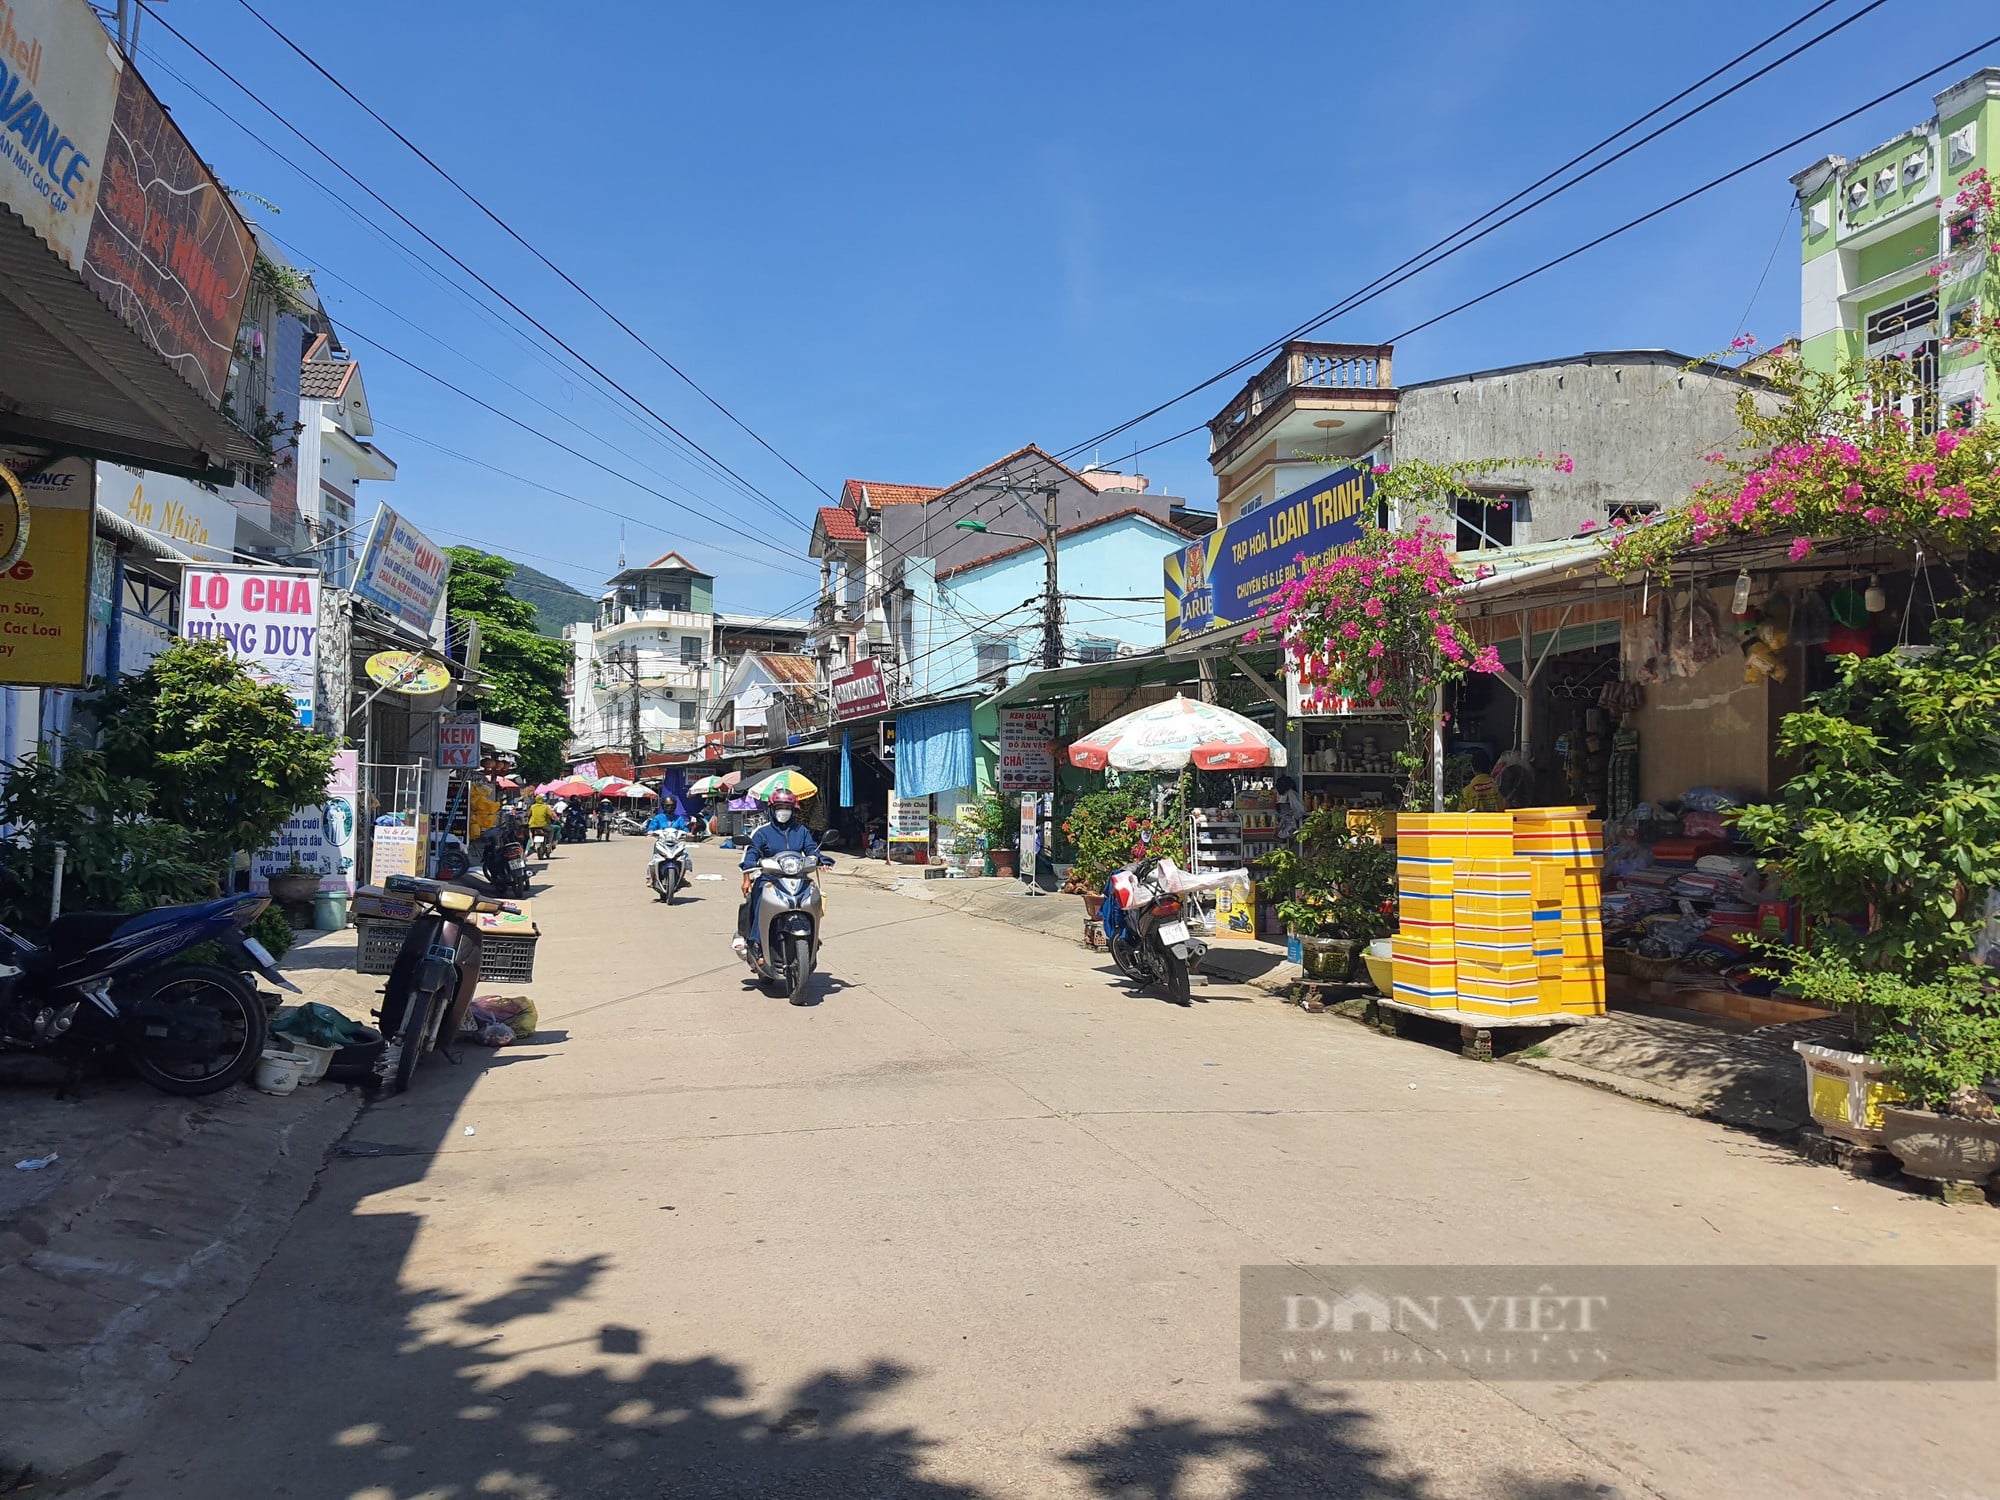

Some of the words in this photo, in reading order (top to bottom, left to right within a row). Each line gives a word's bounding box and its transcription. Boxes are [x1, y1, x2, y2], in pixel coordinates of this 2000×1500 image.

[0, 1, 43, 87] hell
[33, 172, 50, 197] CAO
[125, 482, 153, 526] An
[1231, 541, 1247, 566] TẠP
[1250, 529, 1268, 557] HÓA
[1269, 500, 1309, 550] LOAN
[1312, 475, 1364, 530] TRINH
[189, 571, 229, 610] LÒ
[241, 573, 312, 615] CHẢ
[1269, 574, 1275, 586] &
[1285, 564, 1297, 580] BIA
[263, 624, 317, 657] DUY
[440, 728, 475, 744] KEM
